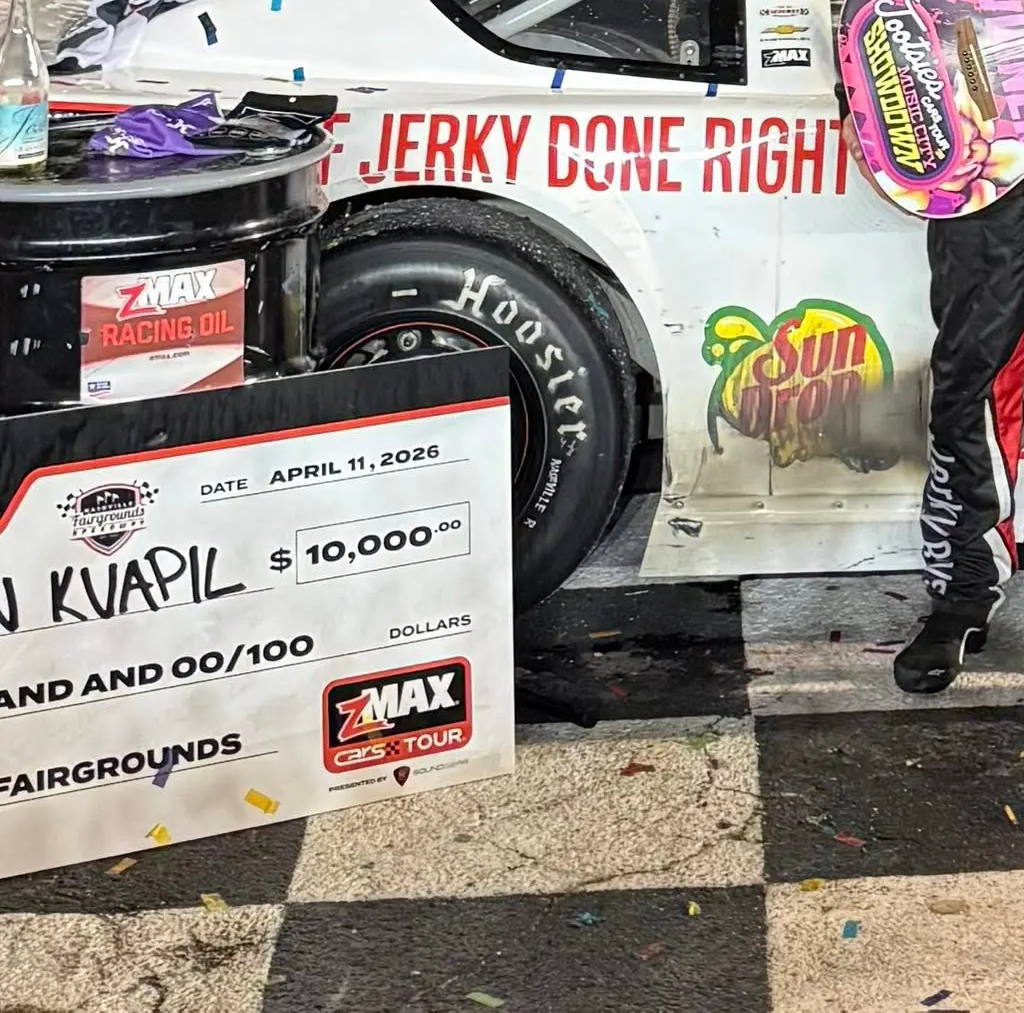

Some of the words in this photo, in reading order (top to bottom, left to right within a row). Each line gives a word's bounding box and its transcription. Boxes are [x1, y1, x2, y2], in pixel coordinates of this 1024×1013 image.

[863, 16, 925, 174] SHOWDOWN
[359, 113, 531, 185] JERKY
[549, 114, 684, 193] DONE
[702, 115, 848, 196] RIGHT
[101, 315, 193, 348] RACING
[199, 309, 235, 337] OIL
[440, 267, 588, 442] Hoosier
[752, 318, 867, 386] Sun
[200, 478, 249, 496] DATE
[269, 460, 342, 486] APRIL
[347, 455, 376, 474] 11,
[381, 444, 441, 468] 2026
[50, 545, 247, 623] KVAPIL
[269, 547, 293, 574] $
[389, 614, 472, 640] DOLLARS
[81, 662, 164, 697] AND
[403, 728, 464, 753] TOUR
